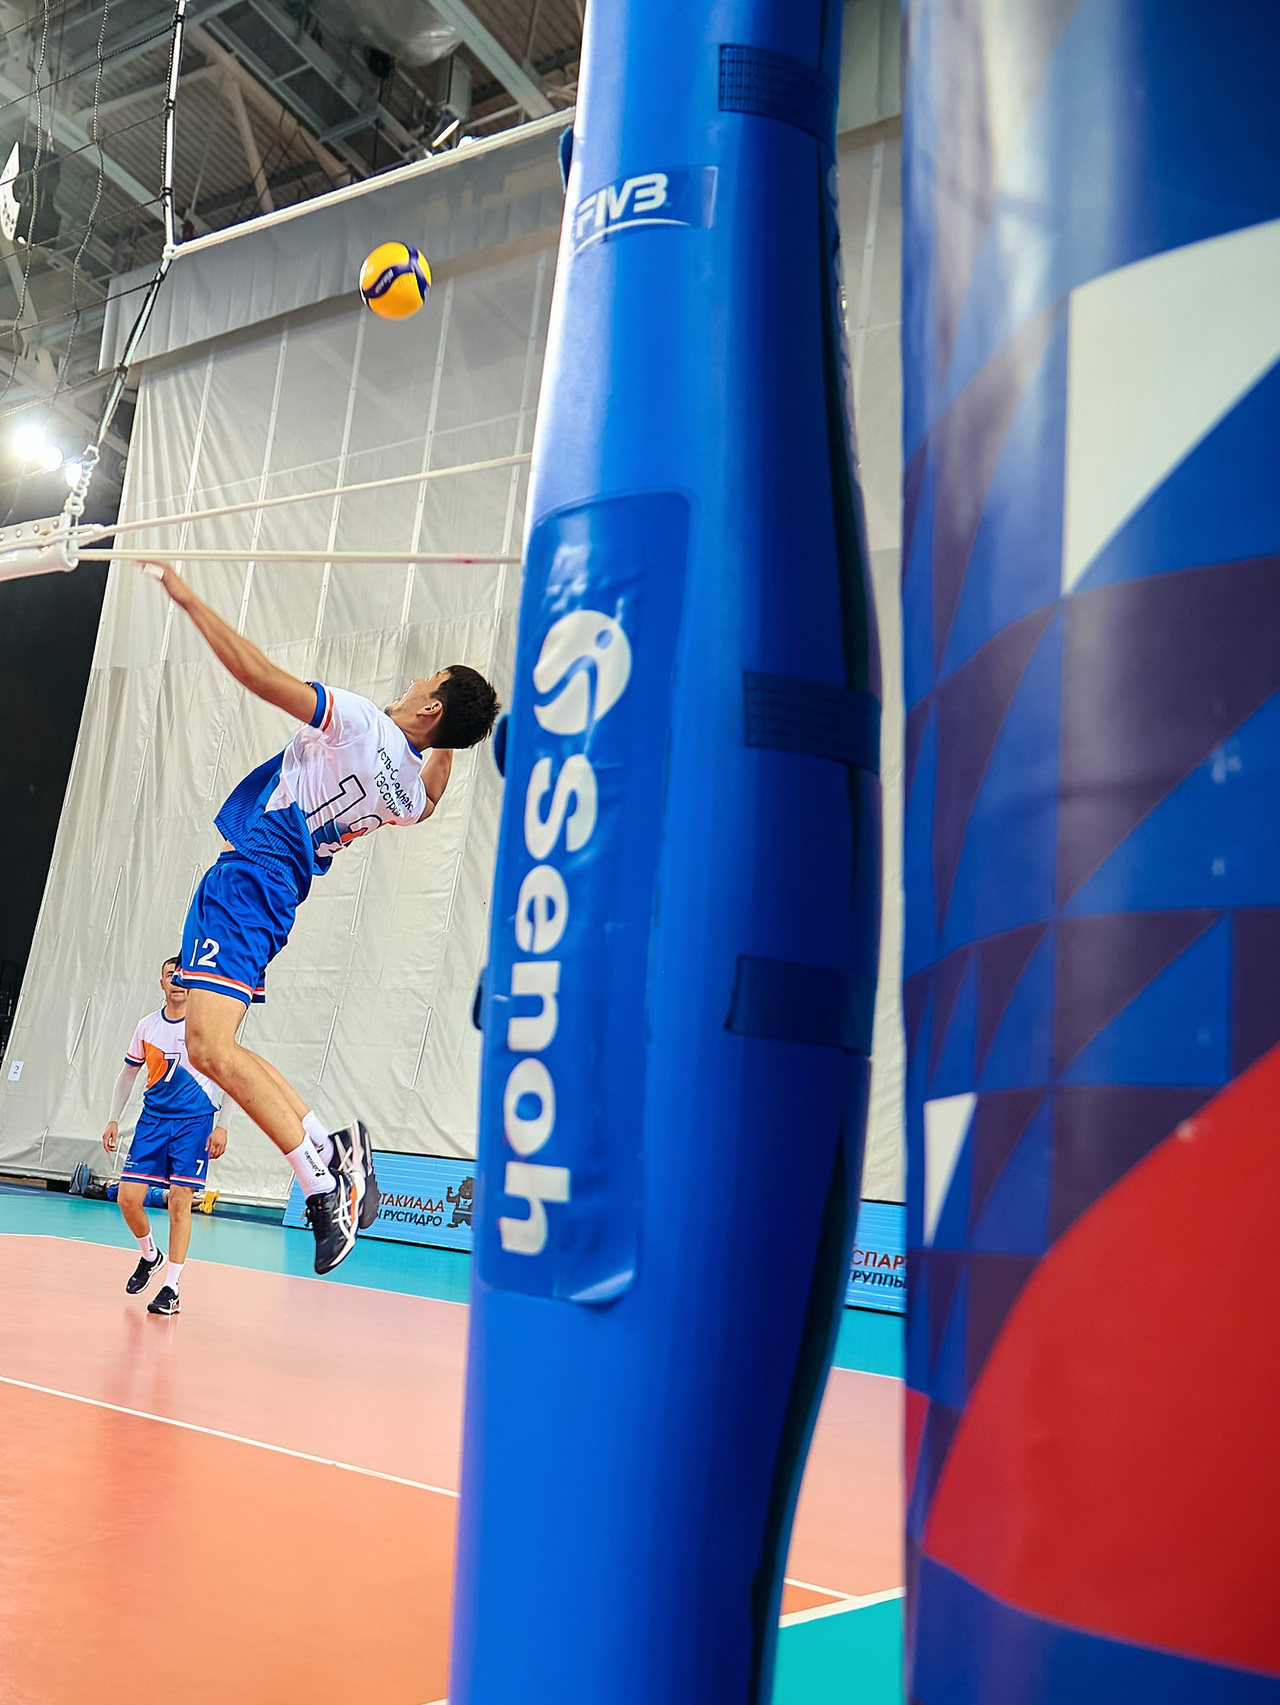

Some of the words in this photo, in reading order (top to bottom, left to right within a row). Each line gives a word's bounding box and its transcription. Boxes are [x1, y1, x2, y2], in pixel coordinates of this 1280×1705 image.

[575, 172, 669, 240] FIVB
[189, 937, 220, 968] 12
[13, 1065, 20, 1075] 2
[163, 1052, 182, 1083] 7
[195, 1159, 205, 1176] 7
[378, 1192, 445, 1214] ТАКИАДА
[383, 1209, 443, 1227] РУСГИДРО
